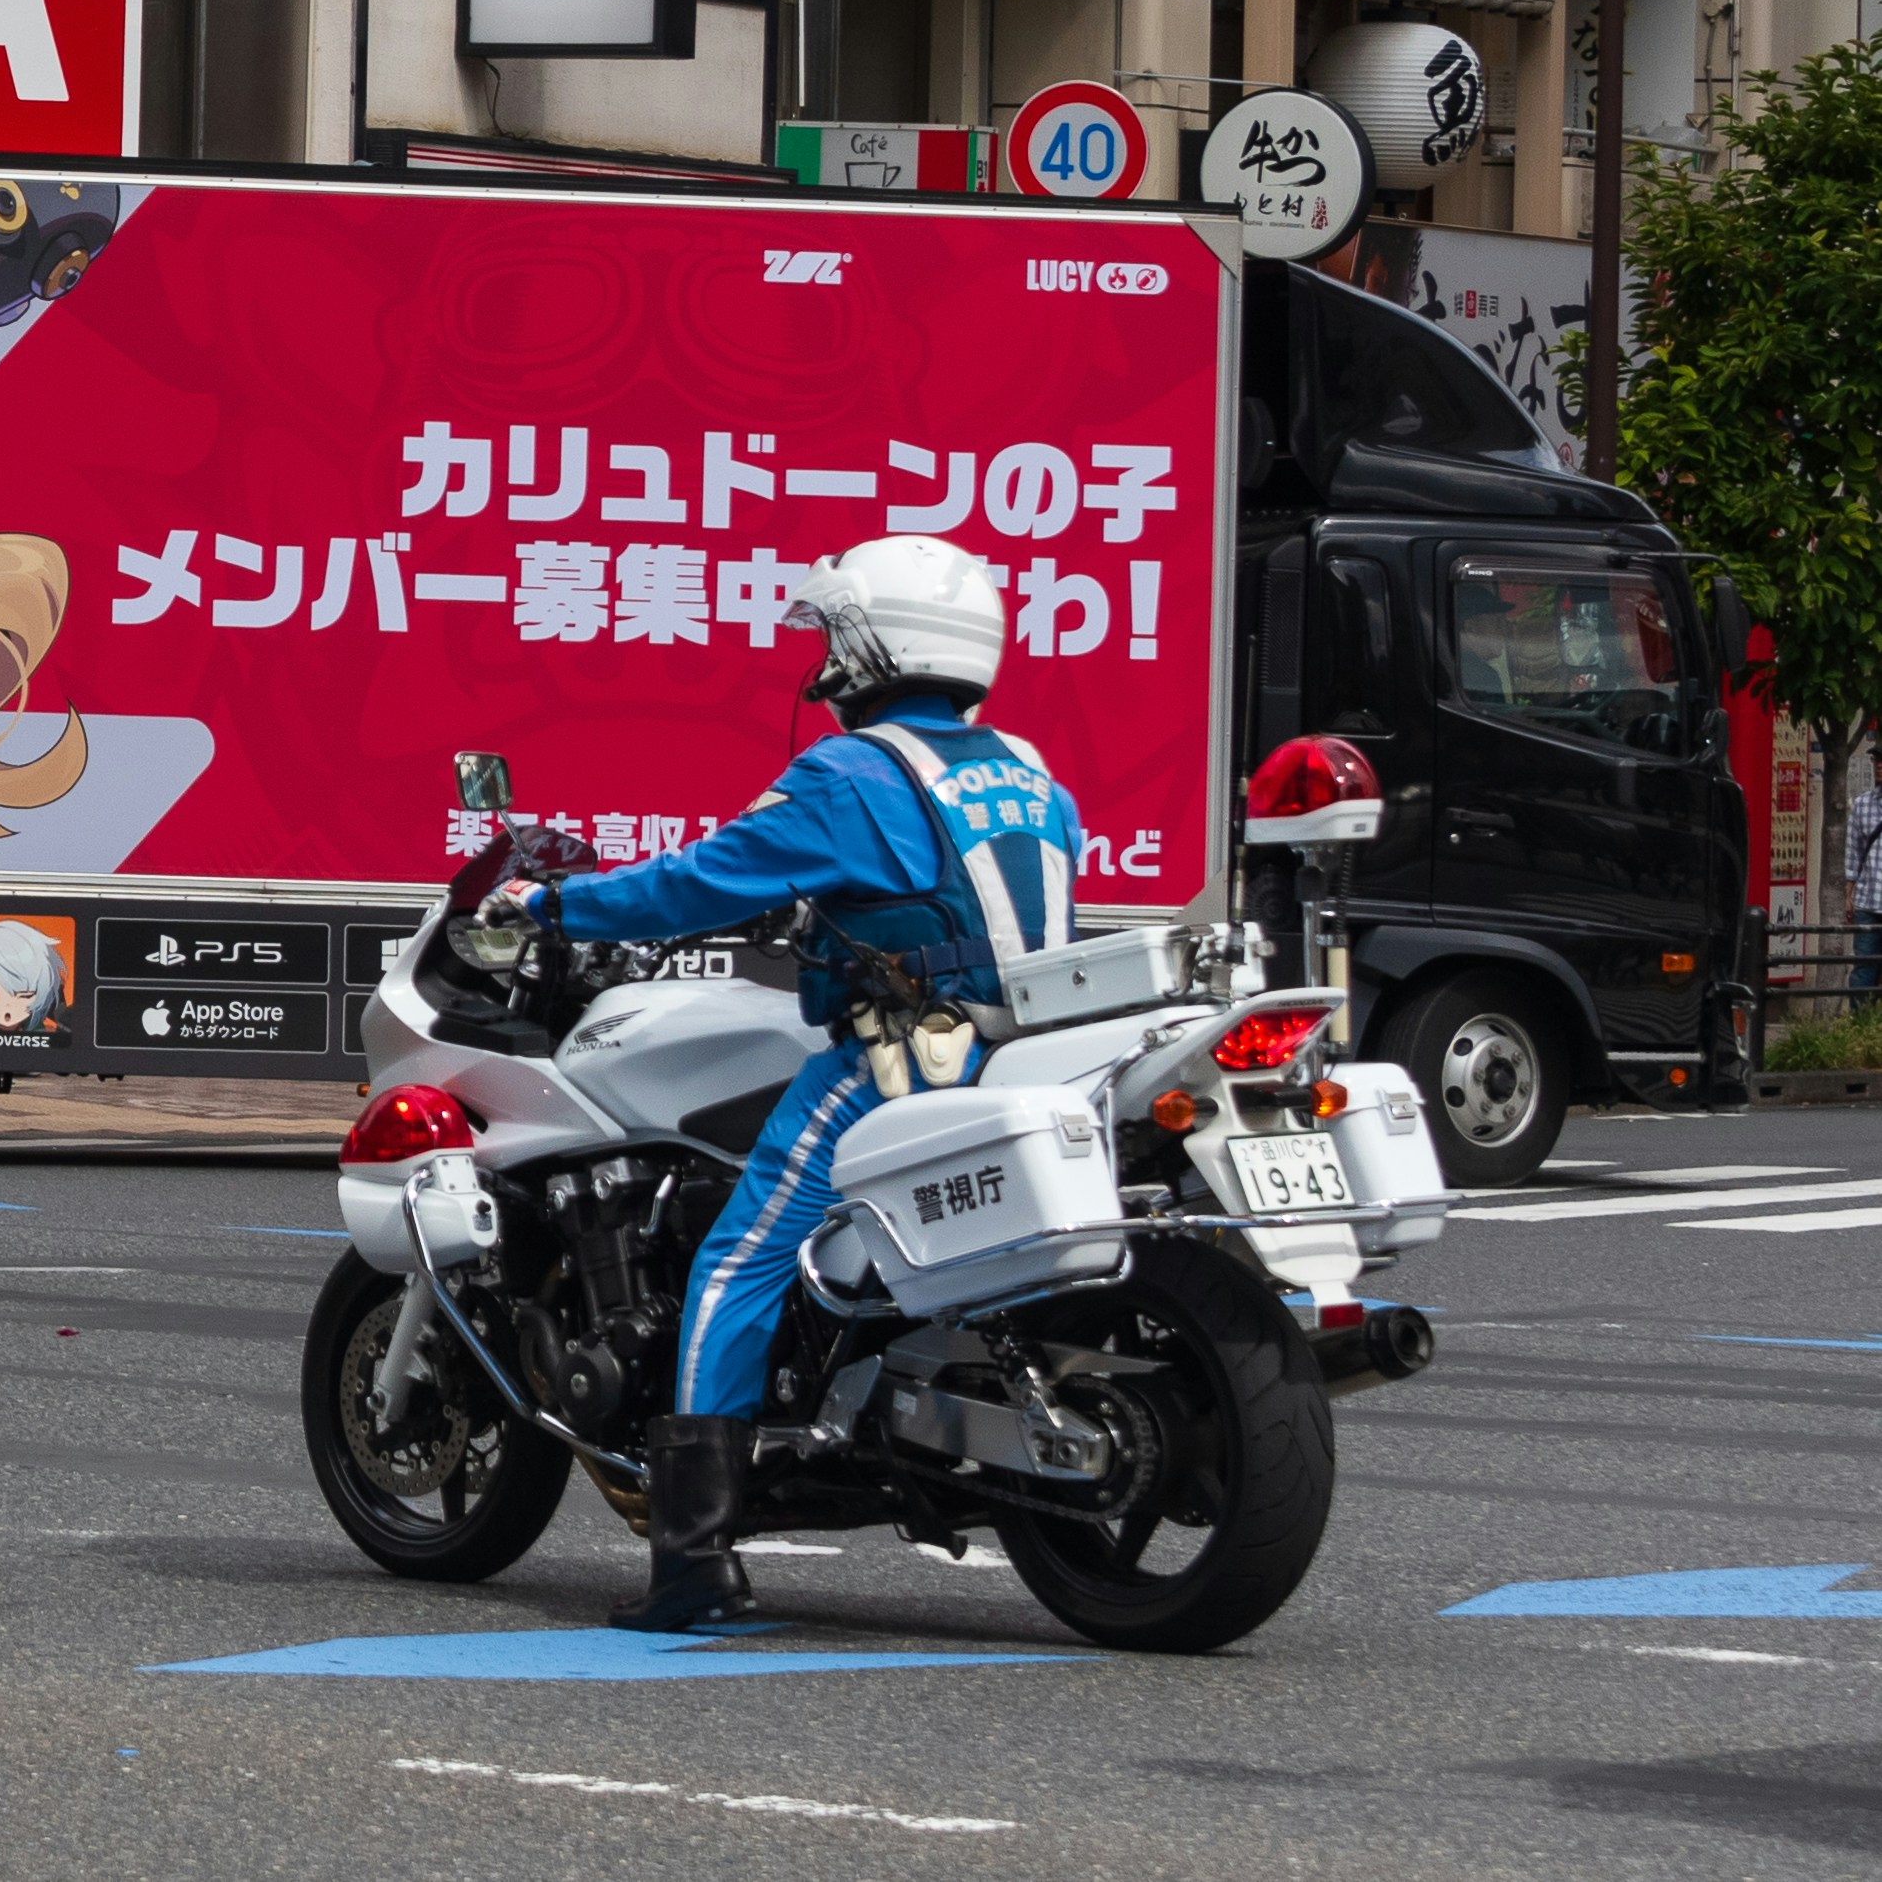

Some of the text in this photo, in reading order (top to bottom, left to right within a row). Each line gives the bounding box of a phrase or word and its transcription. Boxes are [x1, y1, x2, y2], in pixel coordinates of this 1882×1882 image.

[1039, 120, 1116, 182] 40
[1025, 259, 1096, 294] LUCY
[400, 419, 1178, 545] カリュドーンの子
[944, 760, 1052, 806] POLICE
[962, 800, 1048, 830] 警視庁
[181, 1001, 284, 1026] App Store
[179, 1025, 280, 1042] からダウンロード
[566, 1039, 622, 1055] HONDA
[912, 1165, 1005, 1225] 警視庁
